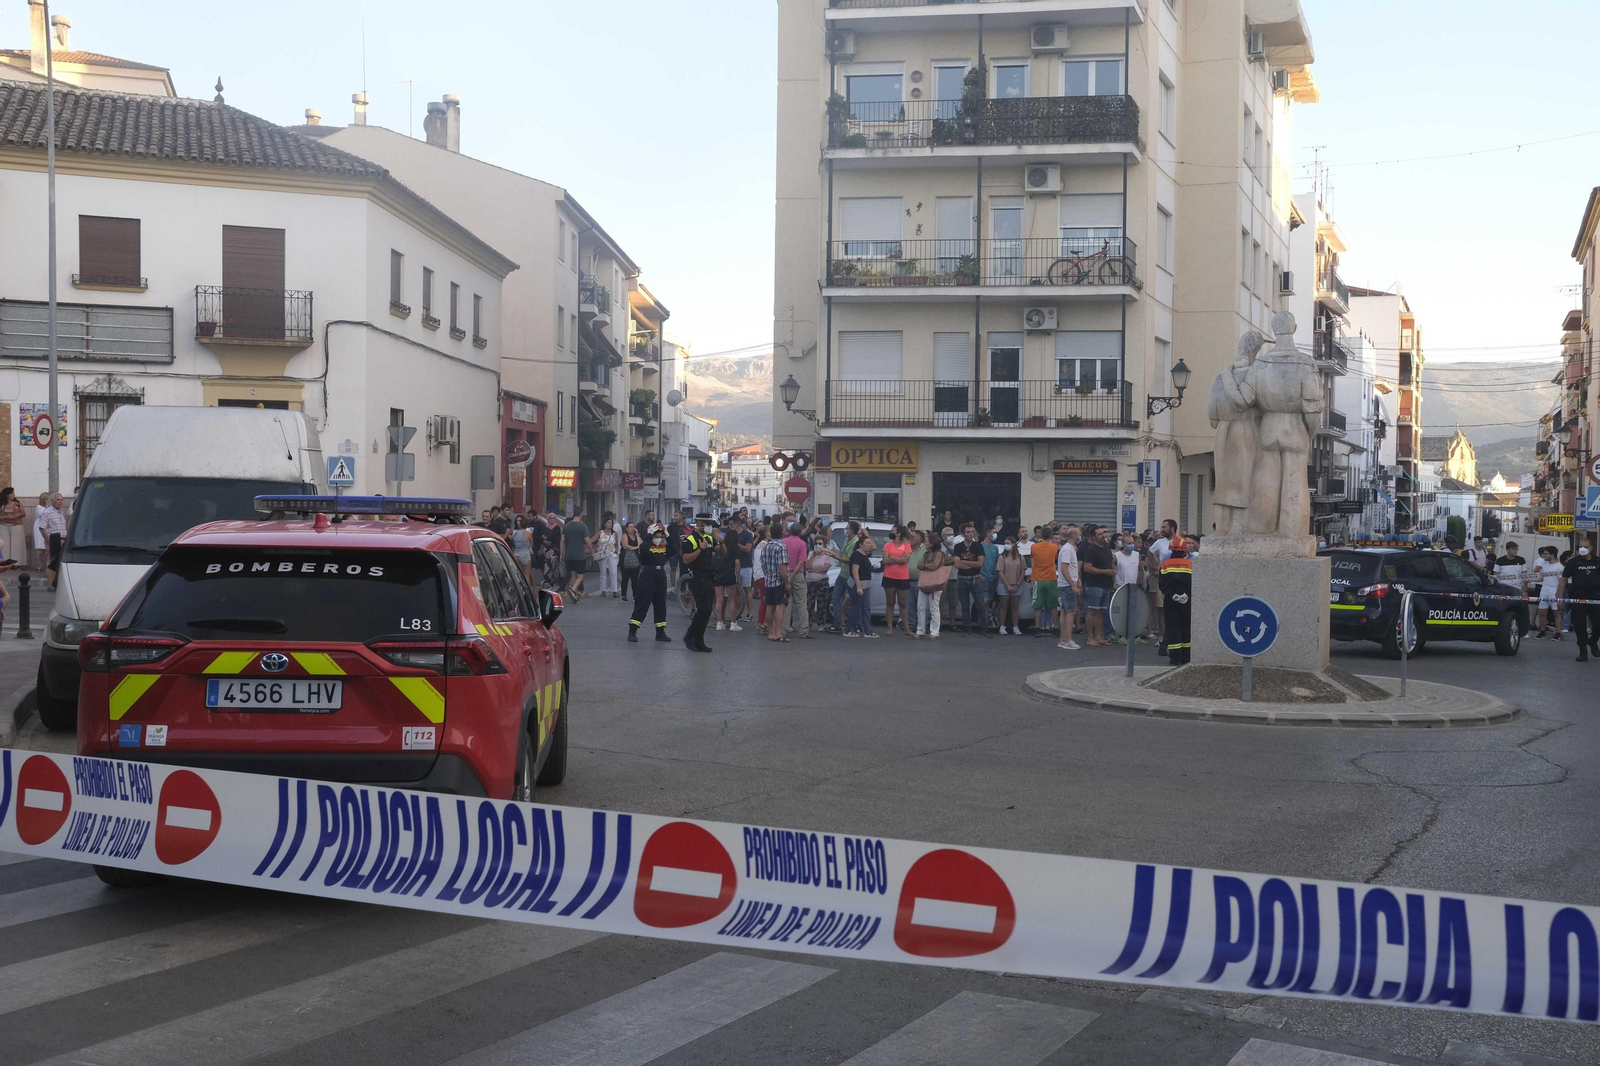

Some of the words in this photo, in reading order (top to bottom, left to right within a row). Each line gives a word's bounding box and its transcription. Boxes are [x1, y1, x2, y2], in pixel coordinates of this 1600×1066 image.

[835, 447, 914, 465] OPTICA
[1060, 461, 1109, 469] TABACOS
[550, 469, 575, 478] DIVER
[551, 478, 574, 487] PARK
[205, 562, 384, 577] BOMBEROS
[1331, 578, 1351, 586] OCAL
[1429, 608, 1461, 620] POLICÍA
[1463, 611, 1489, 620] LOCAL
[400, 617, 431, 631] L83
[223, 682, 283, 704] 4566
[292, 682, 337, 704] LHV
[413, 731, 433, 740] 112
[73, 756, 118, 800] PROHIBIDO
[117, 762, 129, 801] EL
[129, 763, 153, 805] PASO
[61, 810, 94, 853] LINEA
[89, 815, 110, 856] DE
[105, 817, 151, 860] POLICIA
[299, 784, 444, 898] POLICIA
[435, 799, 566, 914] LOCAL
[743, 826, 821, 887] PROHIBIDO
[824, 835, 842, 889] EL
[844, 837, 888, 896] PASO
[717, 899, 783, 941] LINEA
[769, 906, 811, 943] DE
[800, 908, 882, 950] POLICIA
[1196, 875, 1472, 1008] POLICIA
